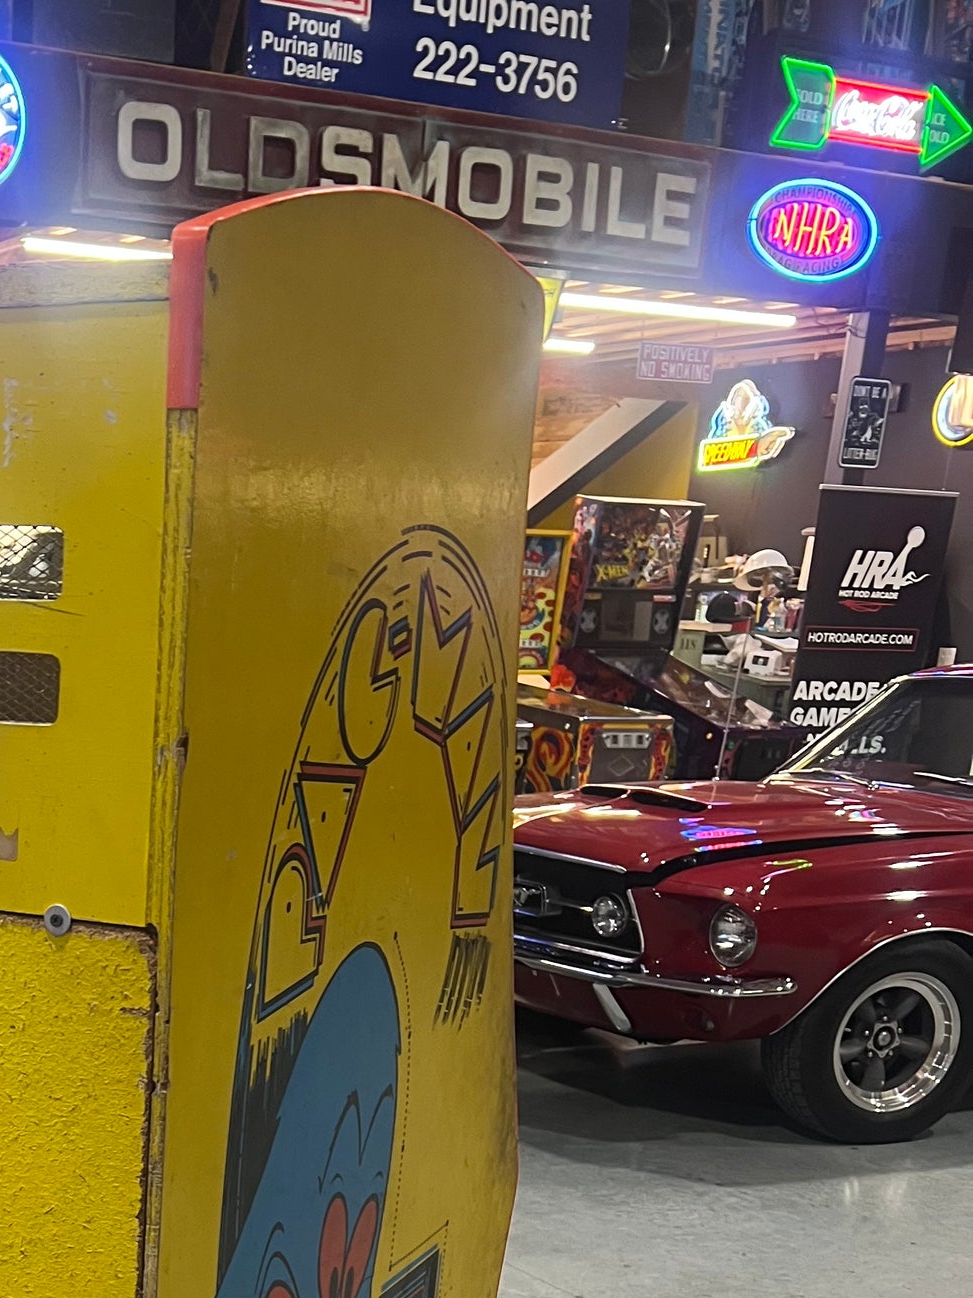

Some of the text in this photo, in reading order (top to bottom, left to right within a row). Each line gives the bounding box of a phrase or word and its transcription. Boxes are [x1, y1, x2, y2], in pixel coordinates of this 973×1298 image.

[288, 12, 342, 39] Proud
[261, 31, 364, 65] Purina Mills
[283, 56, 340, 83] Dealer
[413, 37, 579, 103] 222-3756
[798, 88, 824, 106] OLD
[118, 101, 698, 247] OLDSMOBILE
[770, 202, 856, 257] NHRA
[642, 343, 710, 363] POSITIVELY
[640, 360, 711, 381] NO SMOKING
[595, 563, 629, 583] X-MEN
[841, 540, 913, 590] HRA
[838, 589, 899, 600] HOT ROD ARCADE
[807, 632, 914, 646] HOTRODARCADE.COM
[793, 680, 881, 701] ARCADE
[790, 706, 852, 727] GAME
